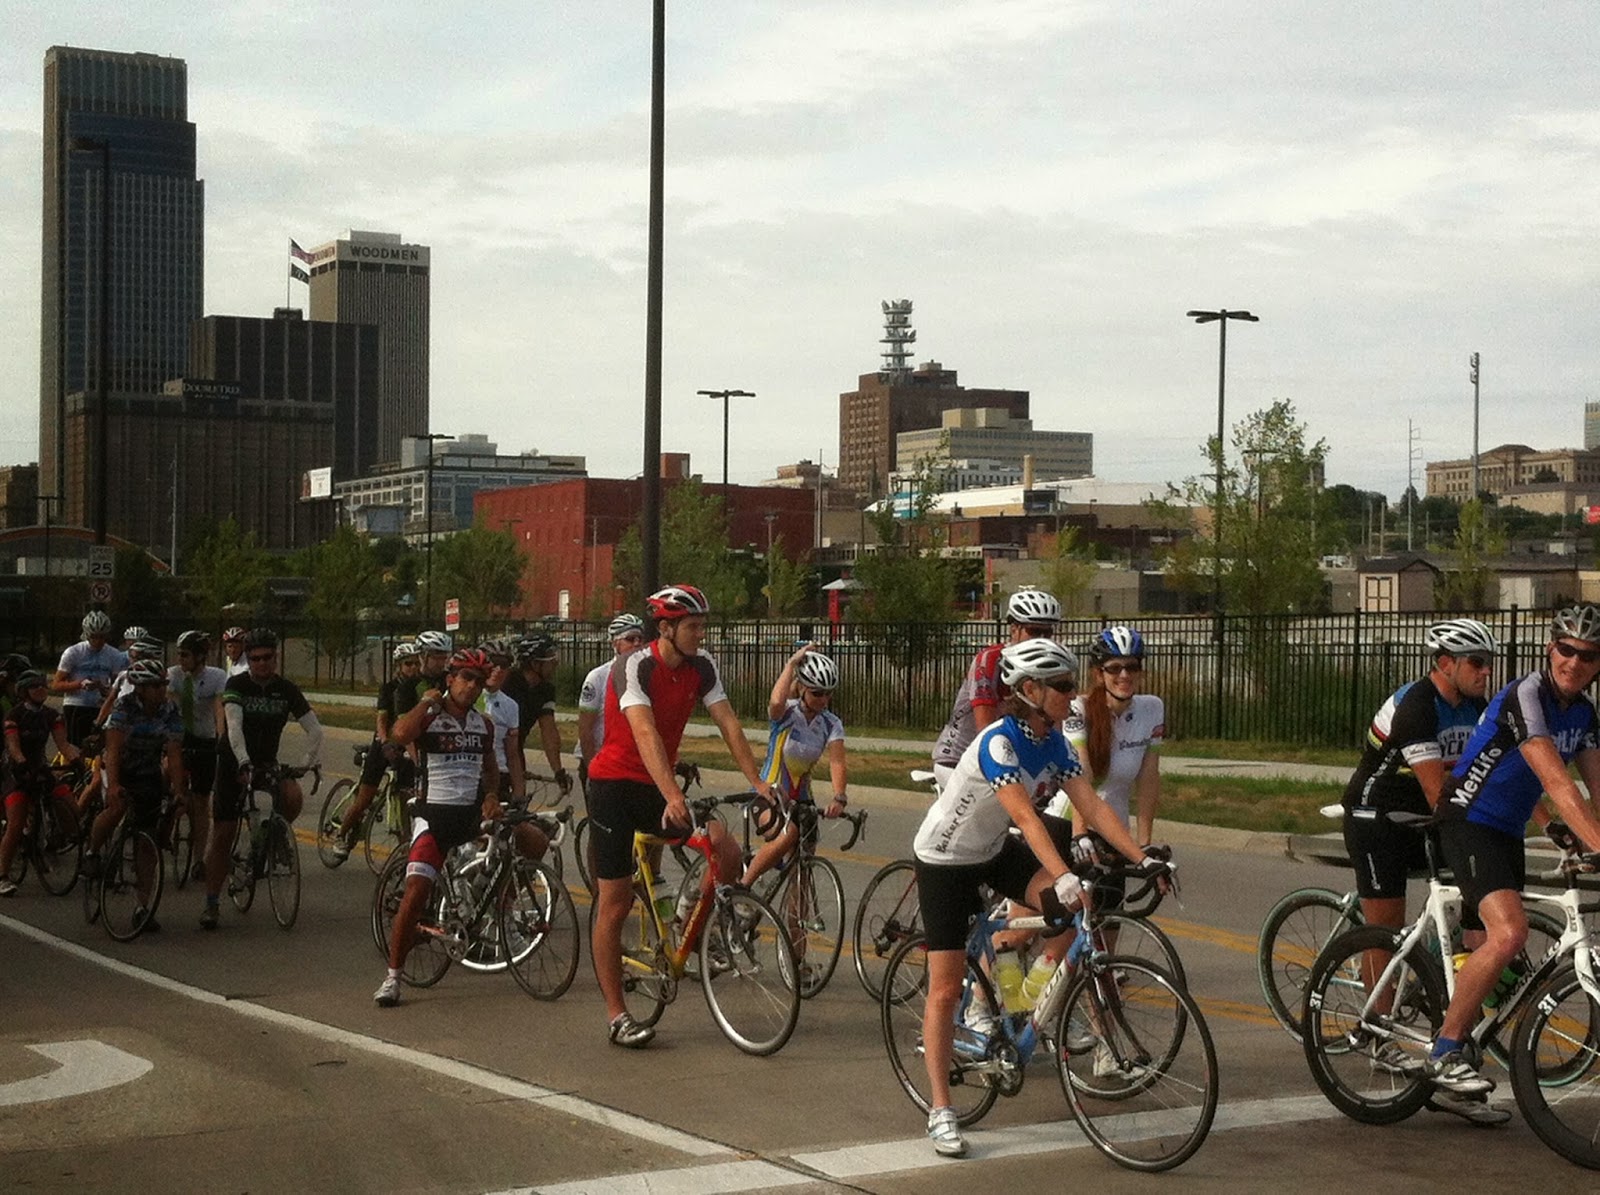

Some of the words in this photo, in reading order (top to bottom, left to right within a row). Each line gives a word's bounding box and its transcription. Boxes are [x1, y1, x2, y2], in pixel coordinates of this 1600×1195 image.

[350, 245, 419, 261] WOODMEN
[91, 562, 112, 575] 25
[454, 734, 483, 748] SHFL
[1449, 747, 1503, 808] MetLife
[935, 817, 961, 853] Baker
[954, 791, 977, 817] City
[1309, 990, 1323, 1010] 3T
[1537, 993, 1558, 1016] 3T
